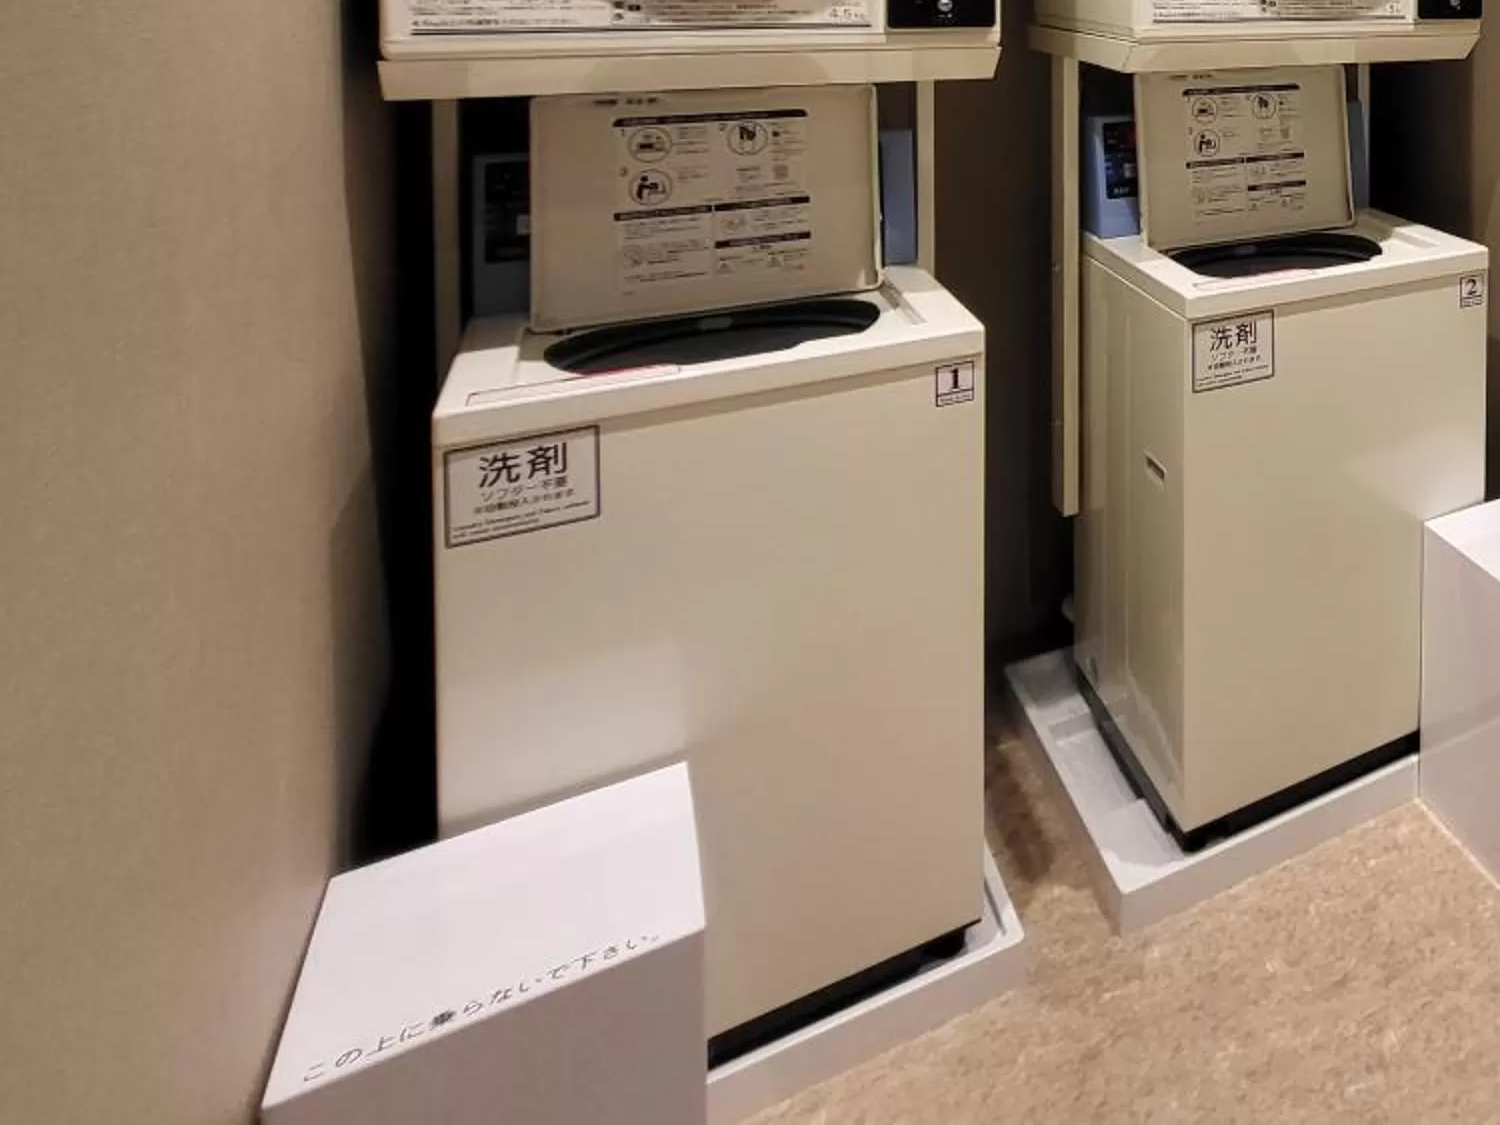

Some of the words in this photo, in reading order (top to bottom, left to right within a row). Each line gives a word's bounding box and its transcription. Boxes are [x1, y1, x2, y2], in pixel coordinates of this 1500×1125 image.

[1466, 278, 1477, 296] 2
[1210, 319, 1257, 352] 洗剤
[949, 367, 960, 391] 1
[478, 441, 568, 488] 洗剤
